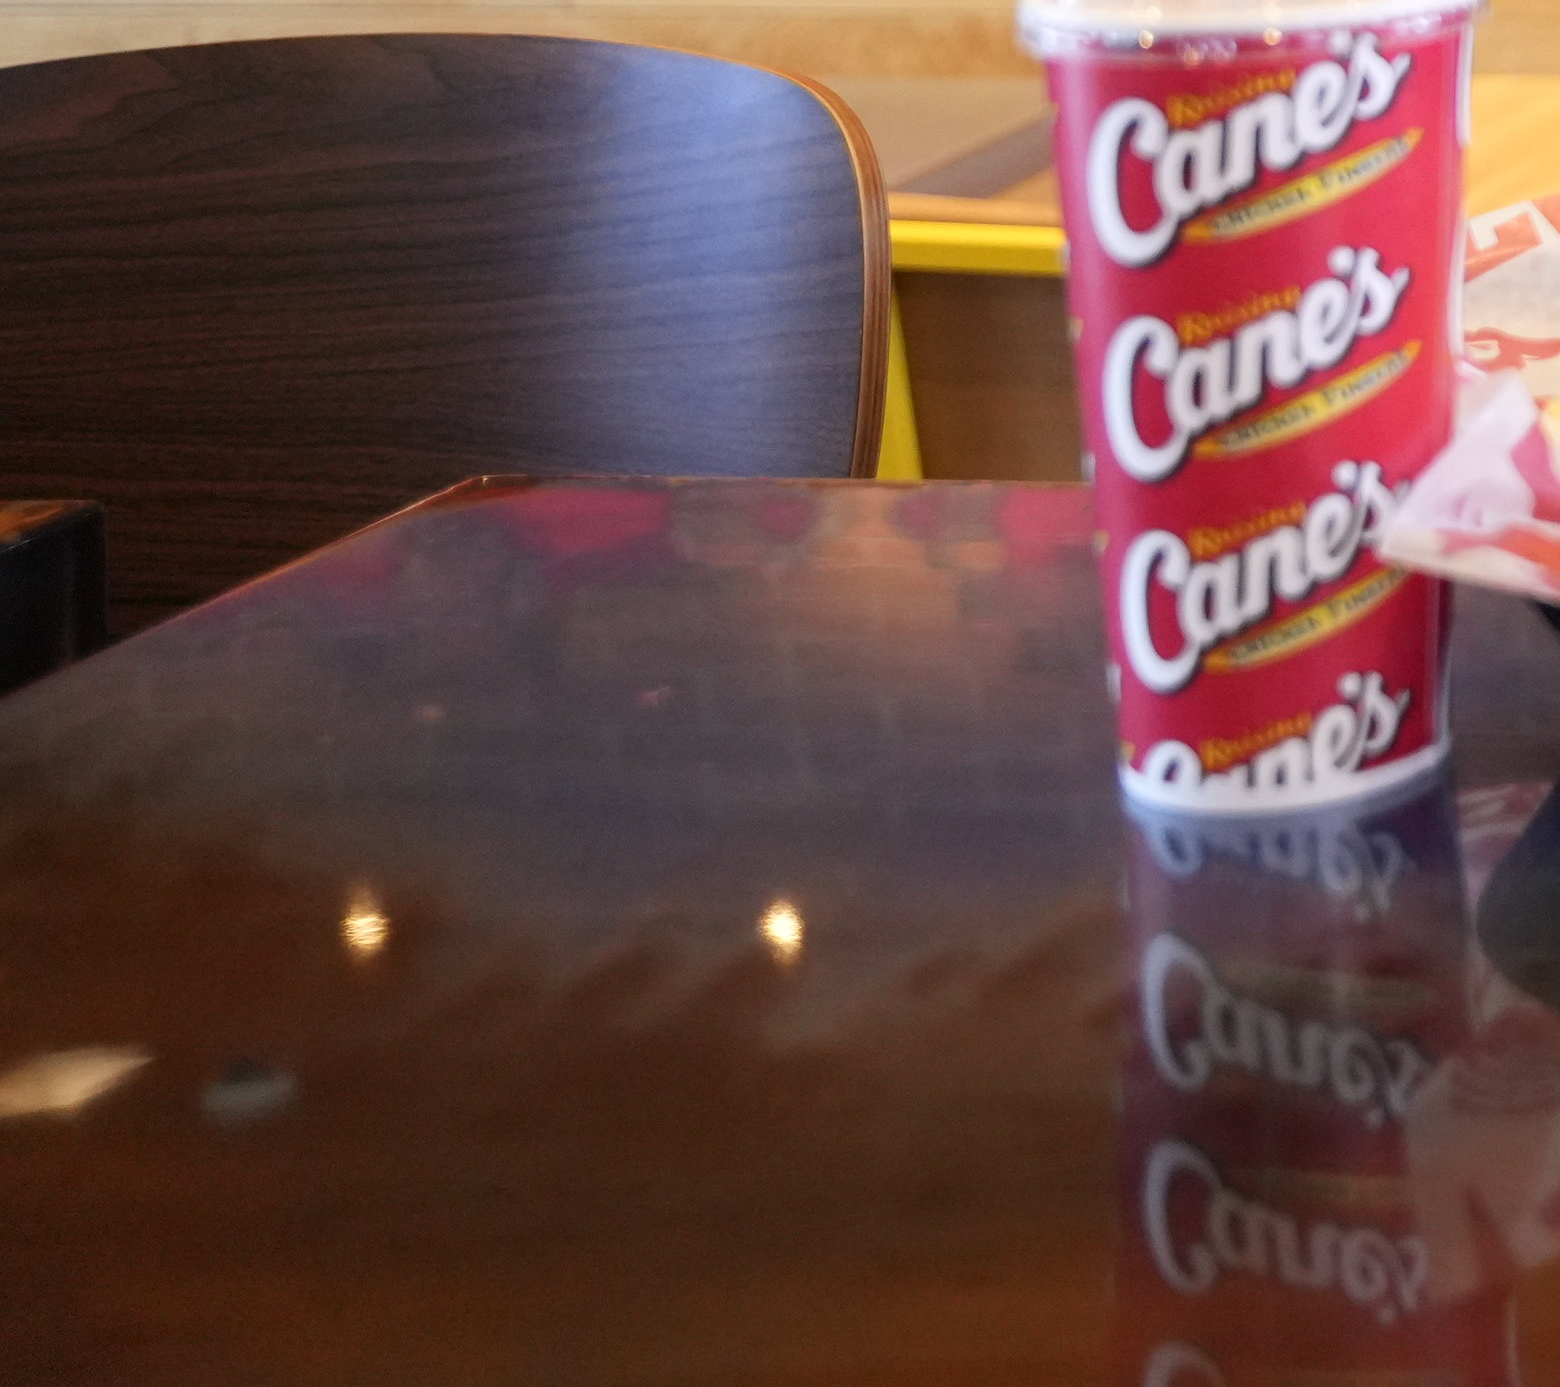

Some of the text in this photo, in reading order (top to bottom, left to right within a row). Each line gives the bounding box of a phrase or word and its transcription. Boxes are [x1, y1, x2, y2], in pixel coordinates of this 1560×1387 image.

[1087, 30, 1411, 265] Cane's
[1102, 245, 1410, 480] Cane's
[1121, 460, 1411, 693] Cane's
